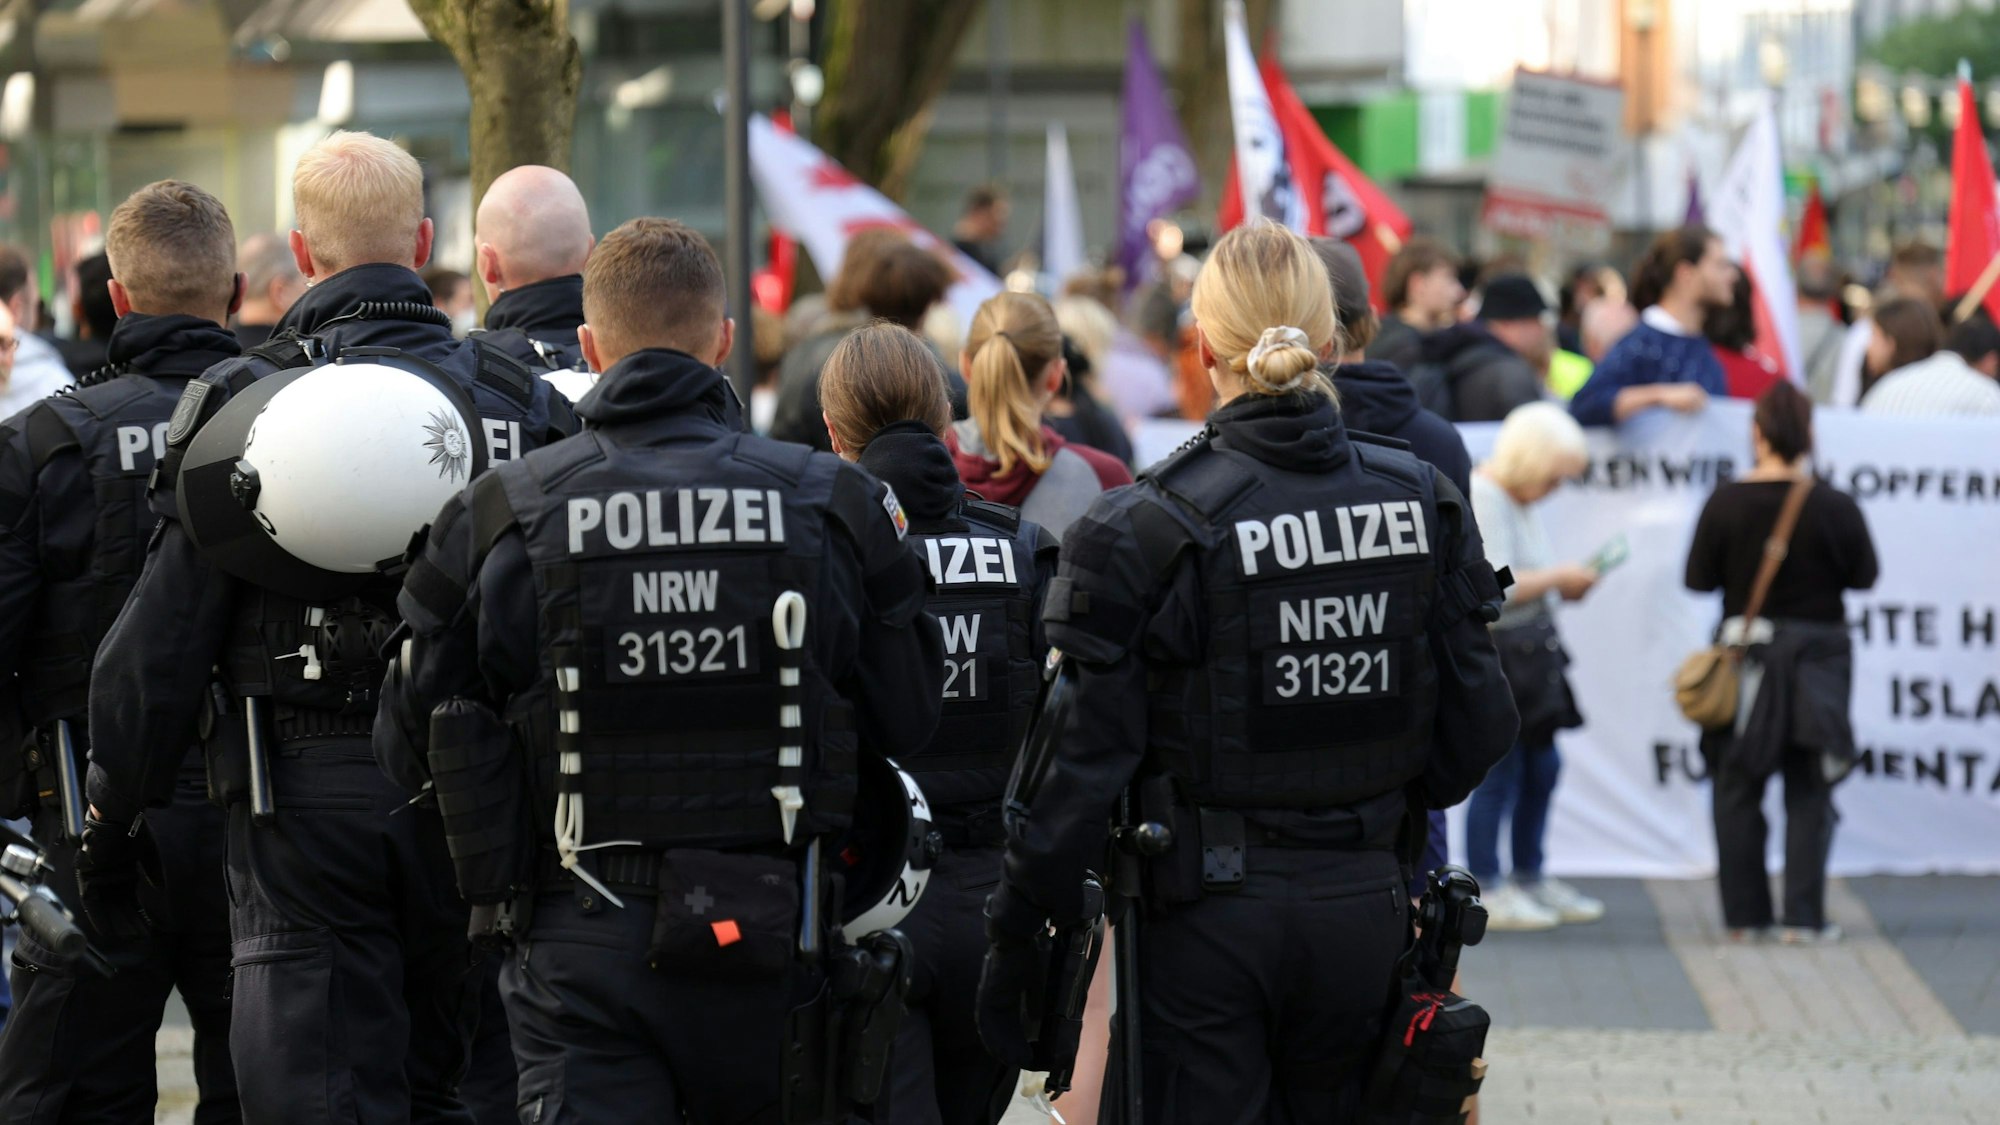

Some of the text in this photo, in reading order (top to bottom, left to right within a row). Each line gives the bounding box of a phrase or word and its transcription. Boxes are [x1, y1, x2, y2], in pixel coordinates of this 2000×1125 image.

[568, 488, 785, 553] POLIZEI
[1235, 500, 1430, 576] POLIZEI
[924, 537, 1018, 584] IZEI
[632, 570, 719, 614] NRW
[1279, 592, 1389, 643] NRW
[618, 625, 747, 676] 31321
[1275, 649, 1389, 698] 31321
